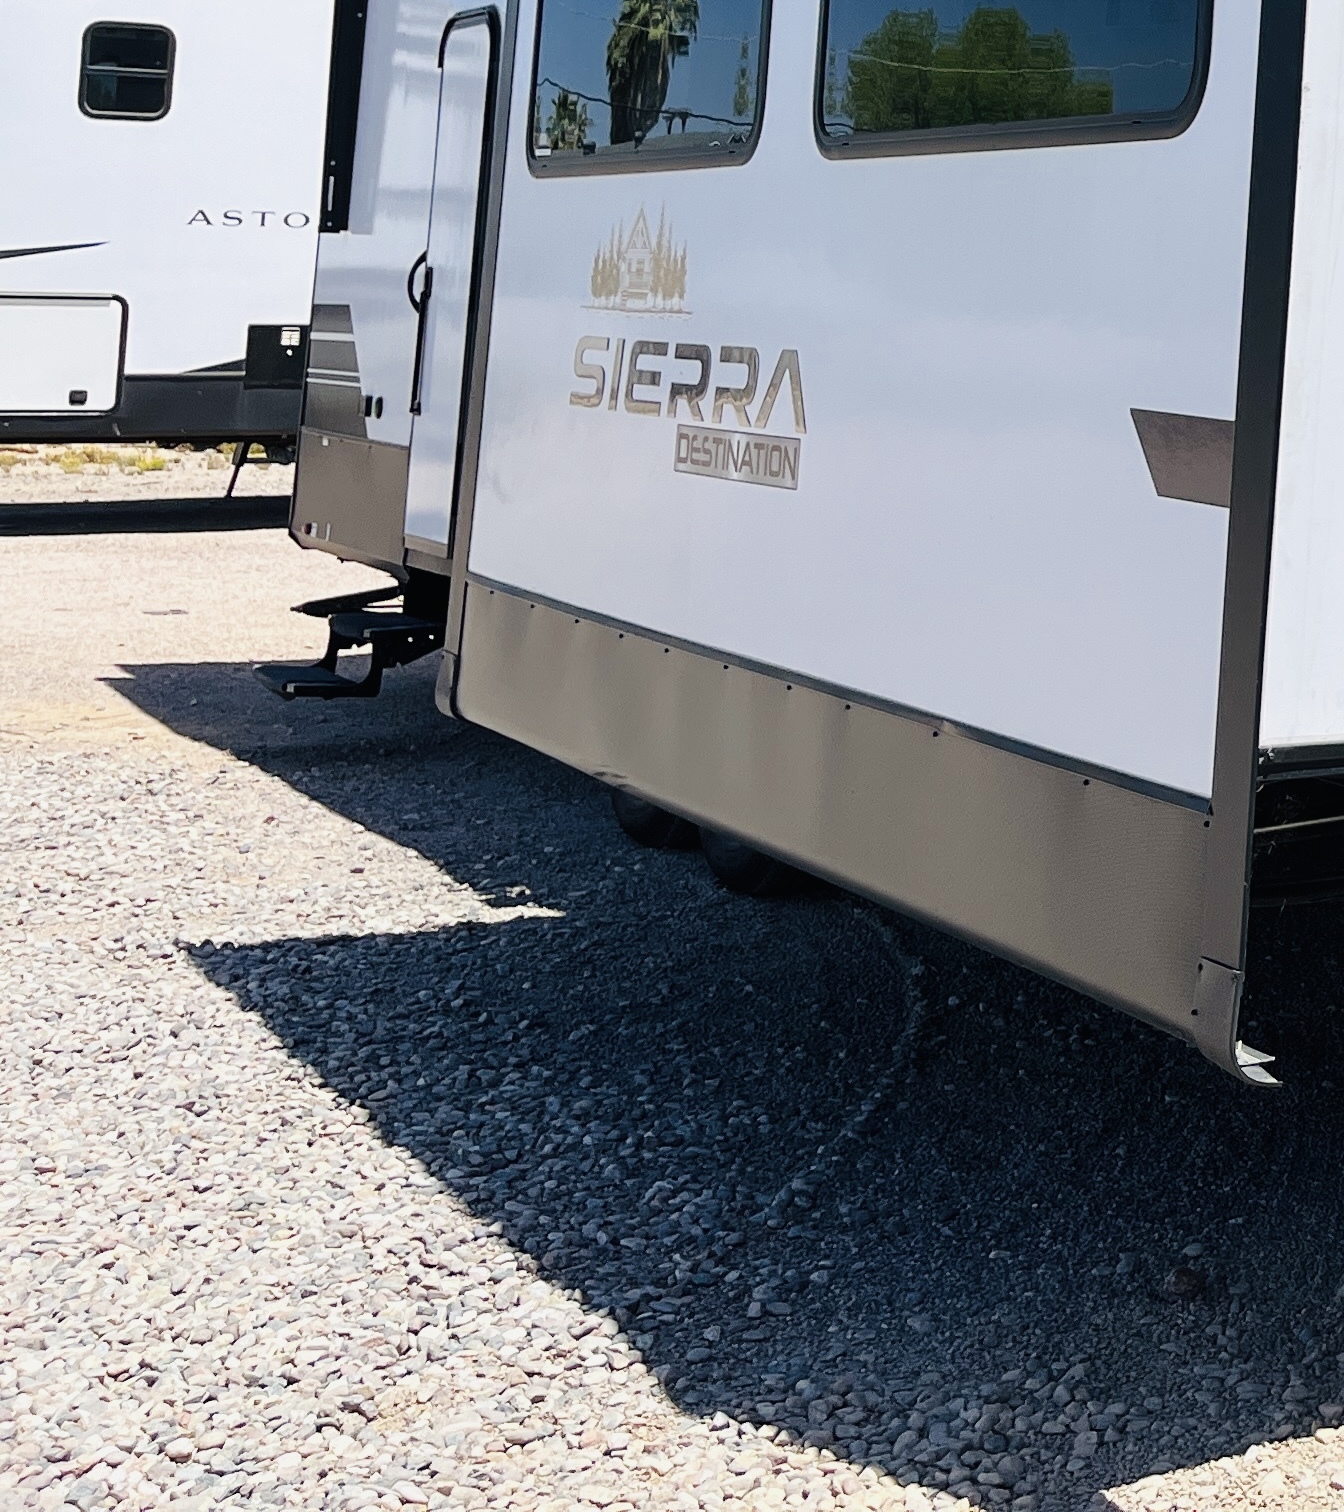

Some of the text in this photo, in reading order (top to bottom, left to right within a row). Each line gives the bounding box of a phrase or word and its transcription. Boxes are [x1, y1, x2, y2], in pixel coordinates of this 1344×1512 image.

[186, 209, 311, 229] ASTO
[569, 335, 807, 435] SIERRA
[676, 432, 798, 482] DESTINATION
